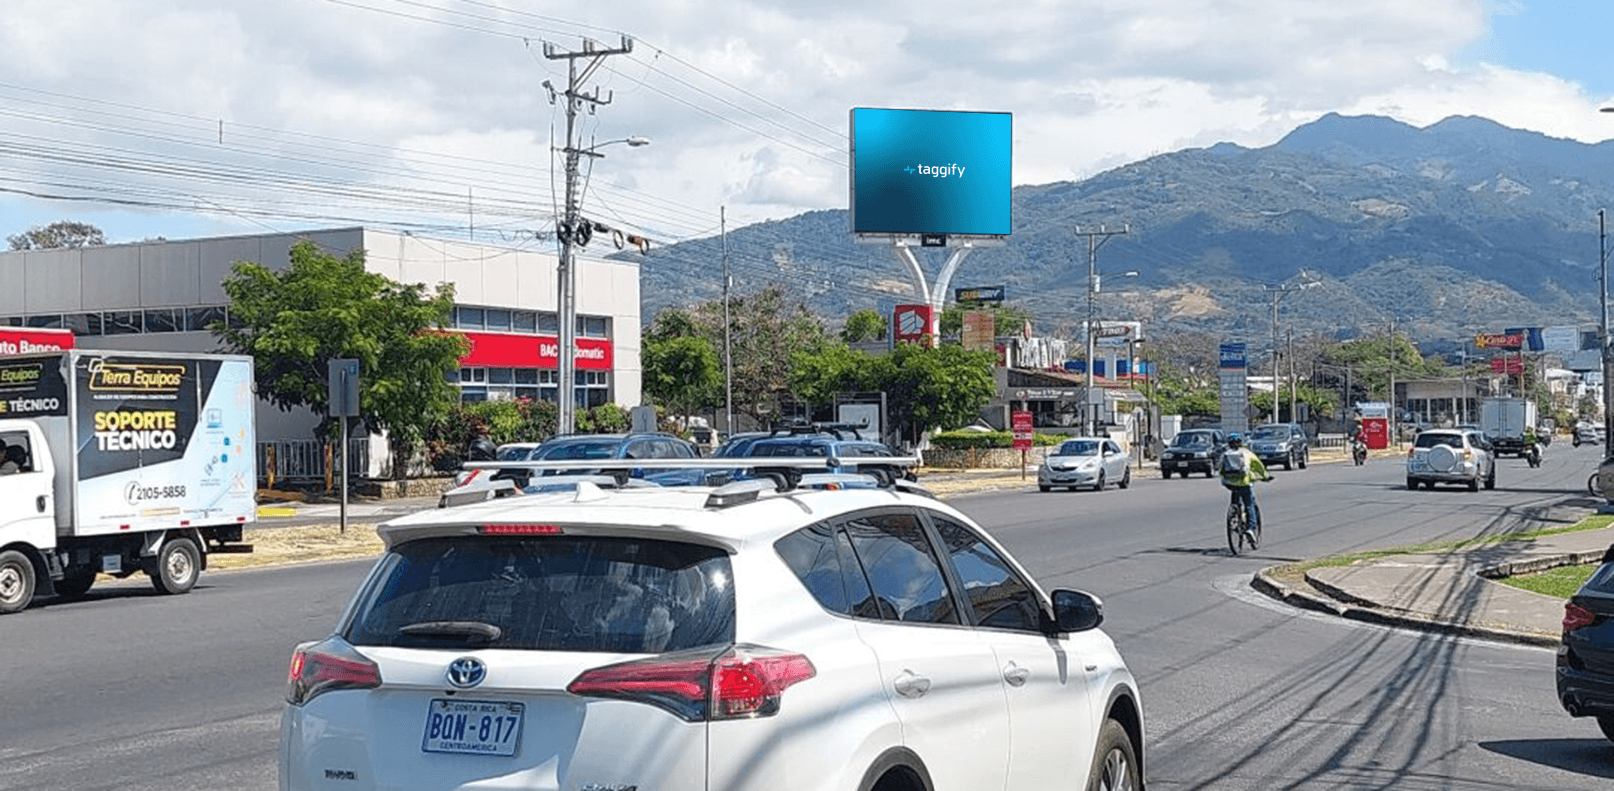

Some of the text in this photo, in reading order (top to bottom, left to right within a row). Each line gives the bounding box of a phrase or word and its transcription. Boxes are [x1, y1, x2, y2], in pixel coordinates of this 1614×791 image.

[917, 163, 966, 178] taggify
[101, 369, 181, 388] Terra Equipos
[9, 397, 59, 412] TÉCNICO
[95, 411, 176, 430] SOPORTE
[95, 427, 176, 451] TÉCNICO
[137, 485, 186, 500] 2105-5858
